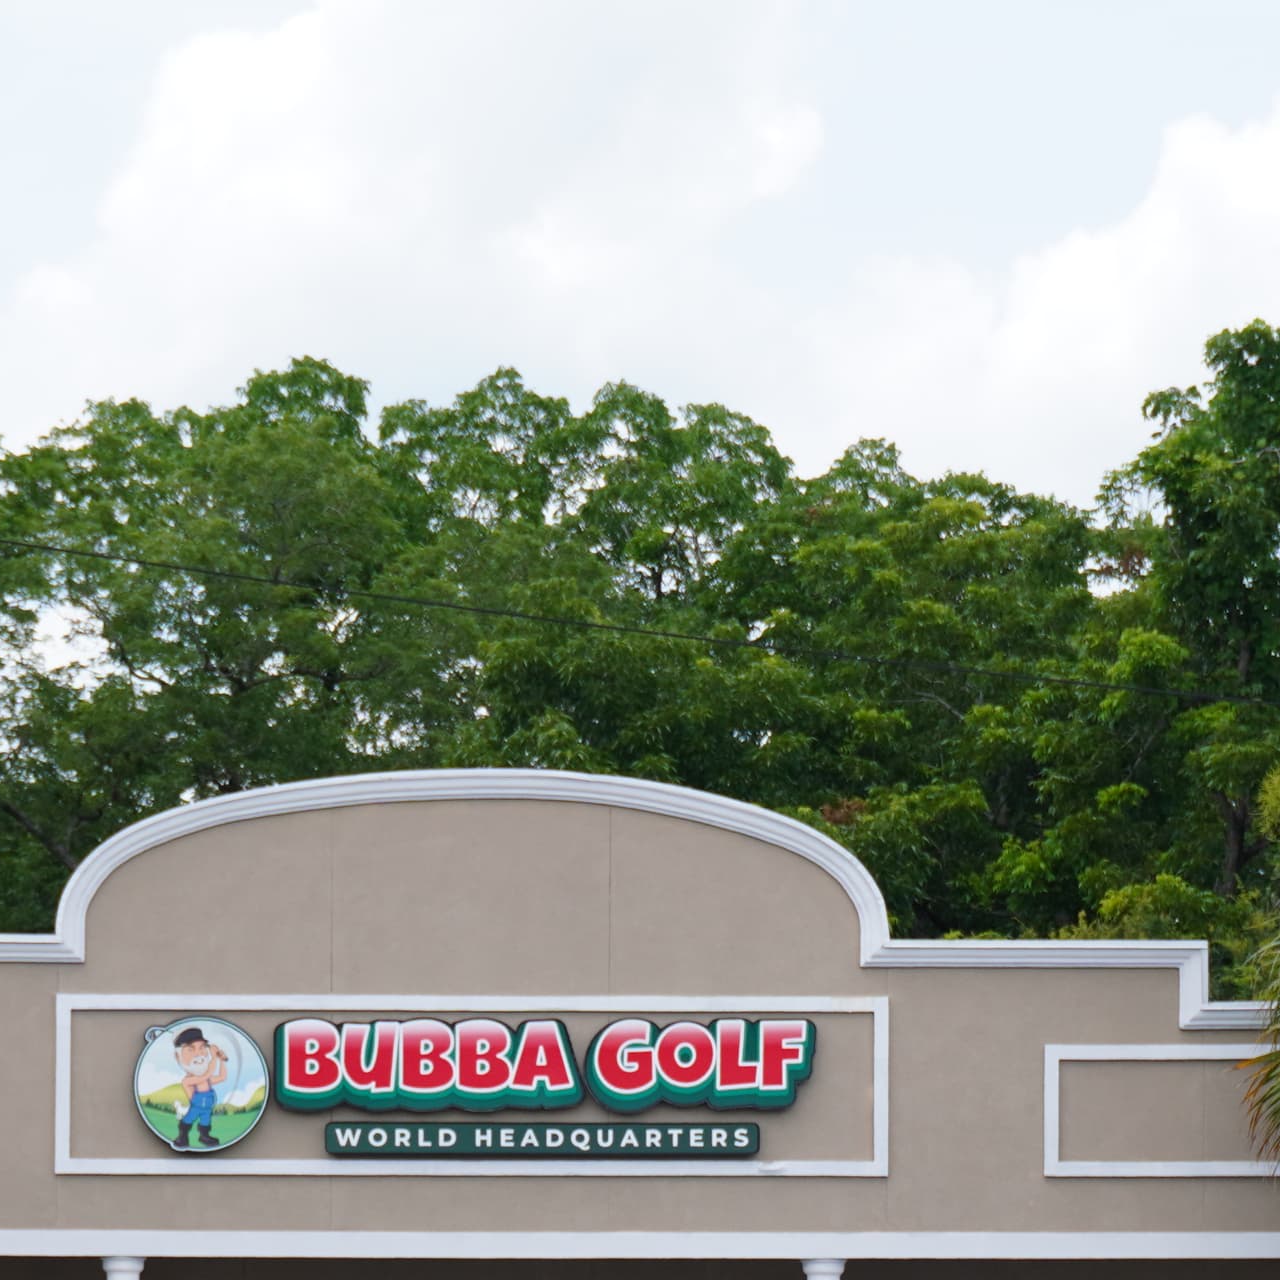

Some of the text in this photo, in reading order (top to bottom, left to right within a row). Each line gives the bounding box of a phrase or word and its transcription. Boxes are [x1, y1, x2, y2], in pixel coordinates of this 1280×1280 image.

[283, 1018, 808, 1095] BUBBA GOLF
[334, 1127, 751, 1151] WORLD HEADQUARTERS
